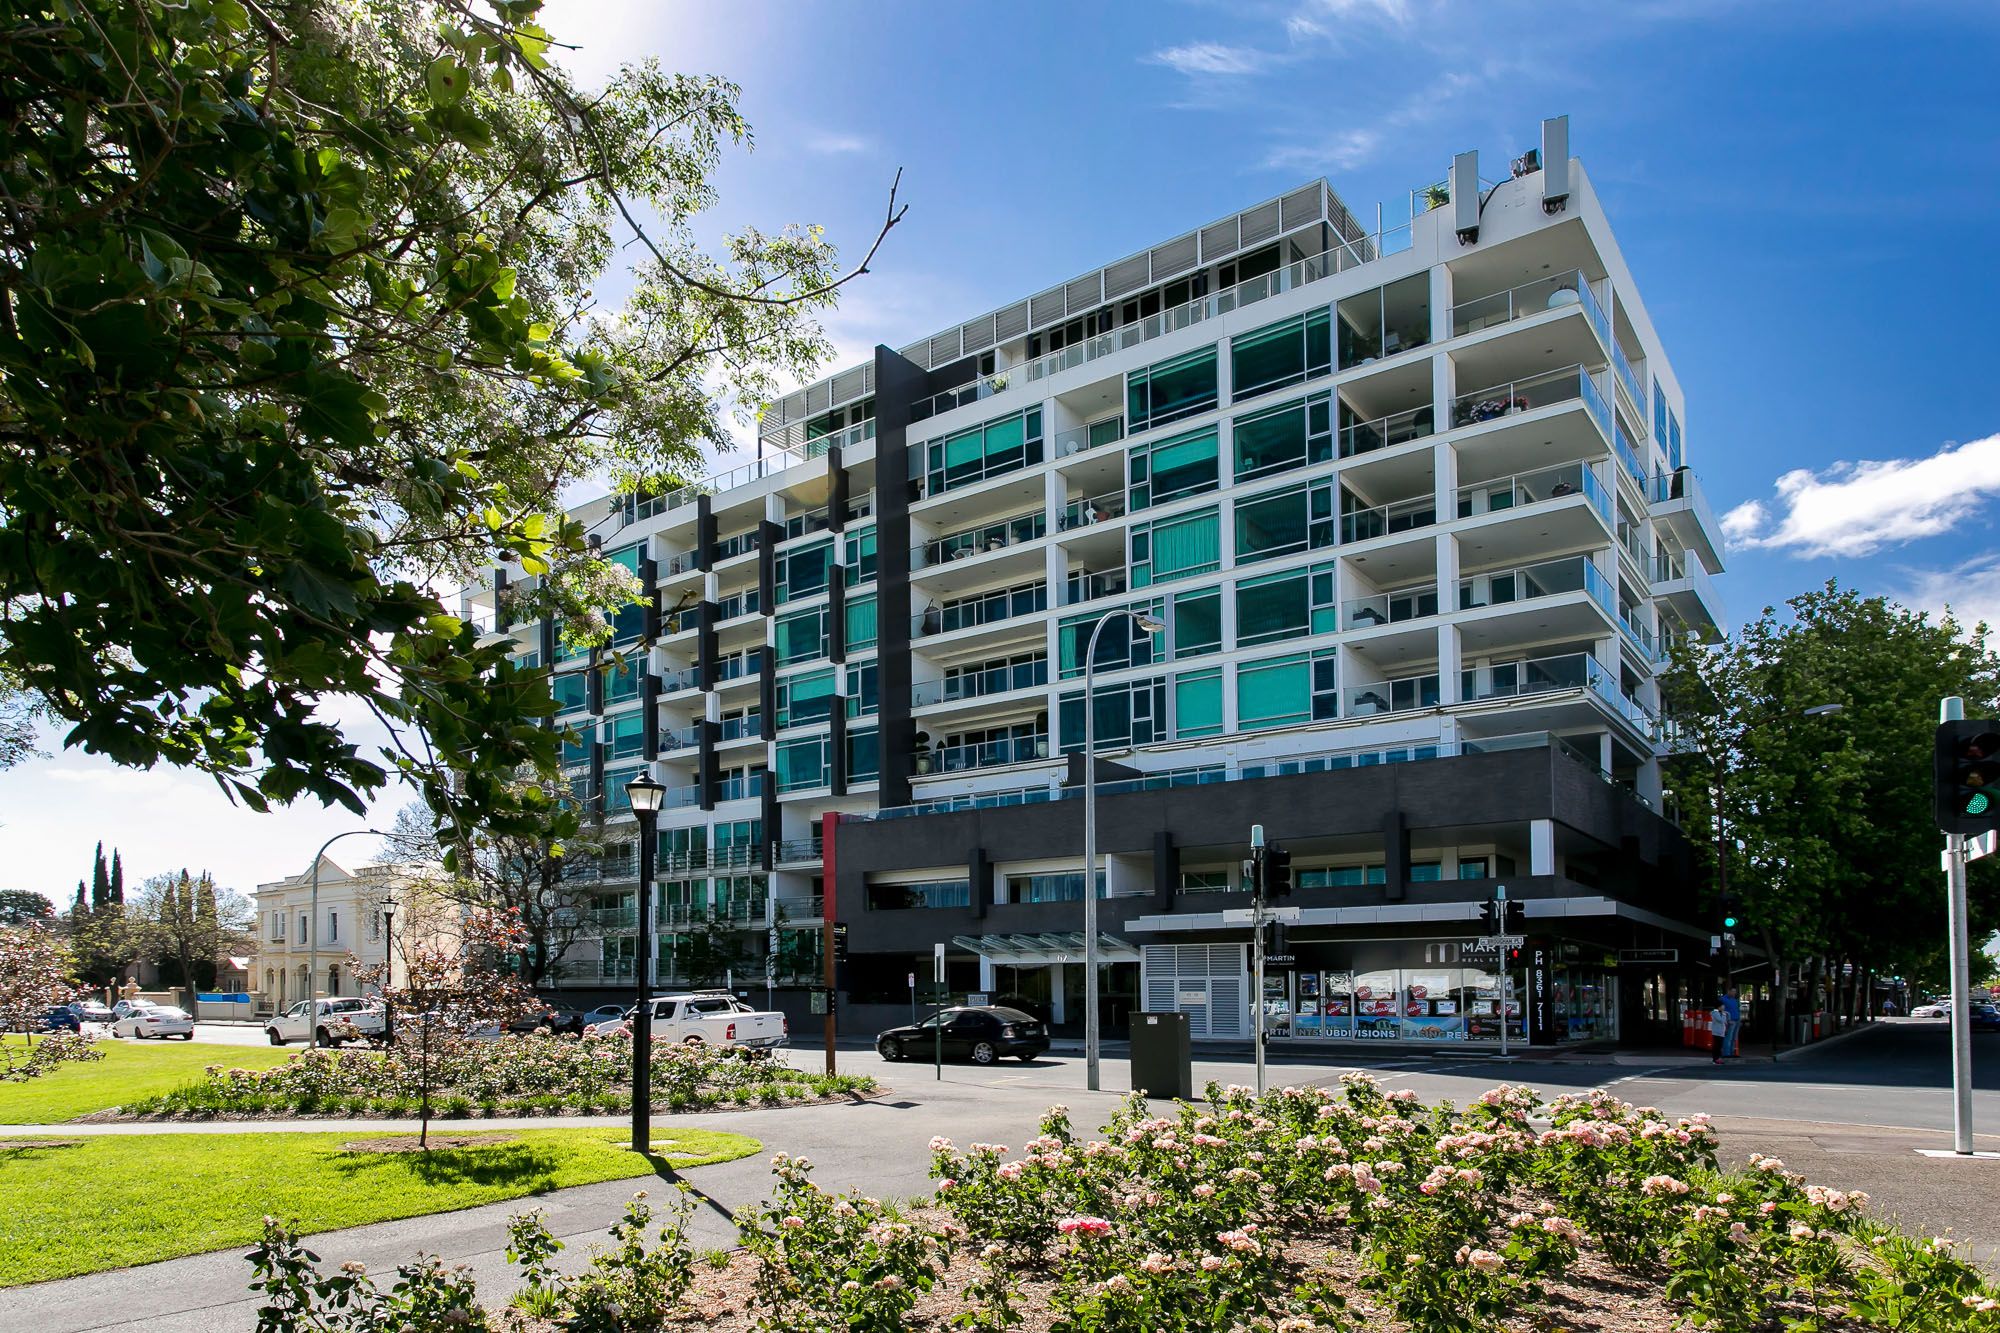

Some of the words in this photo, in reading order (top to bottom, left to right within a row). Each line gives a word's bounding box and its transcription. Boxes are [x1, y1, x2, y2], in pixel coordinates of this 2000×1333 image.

[1267, 954, 1295, 962] MARTIN
[1358, 987, 1371, 997] SOLD
[1412, 986, 1427, 997] SOLD
[1327, 1004, 1342, 1014] SOLD
[1375, 1005, 1389, 1014] SOLD
[1407, 1004, 1422, 1014] SOLD
